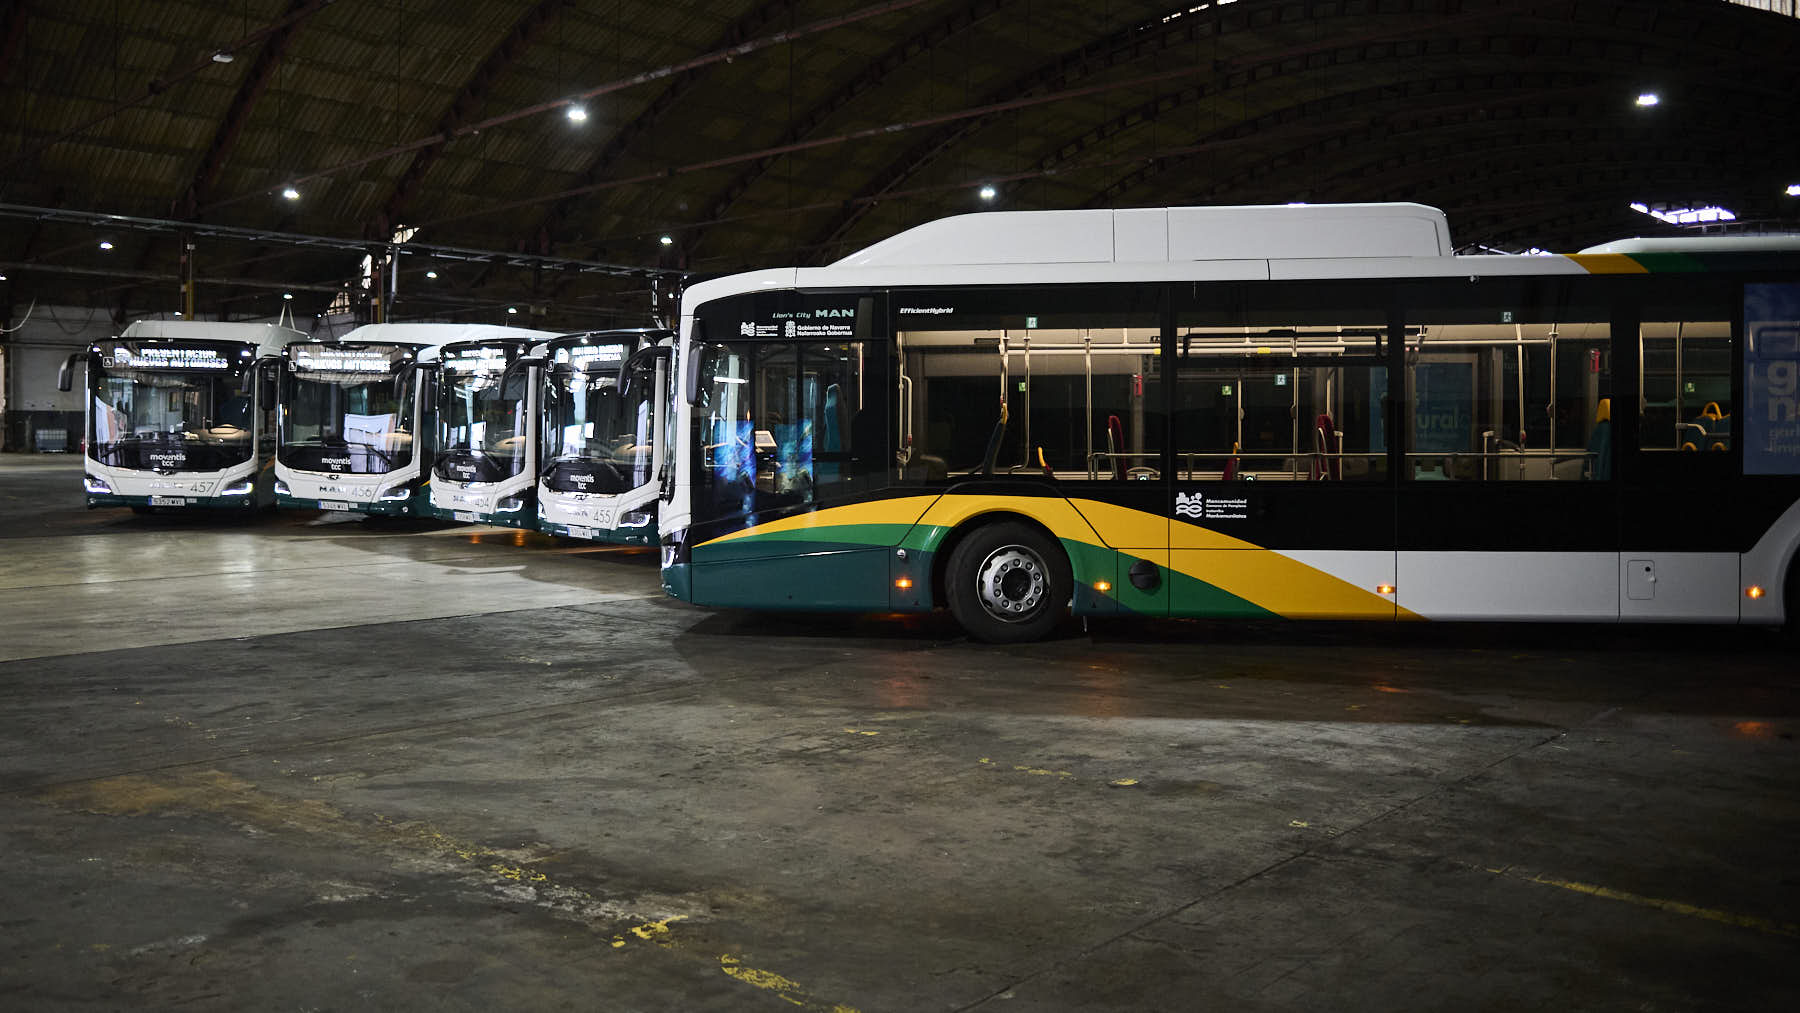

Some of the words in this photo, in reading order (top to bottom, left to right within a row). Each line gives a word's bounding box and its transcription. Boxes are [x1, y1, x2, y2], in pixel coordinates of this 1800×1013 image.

[815, 309, 854, 317] MAN
[190, 481, 214, 493] 457
[593, 509, 611, 523] 455
